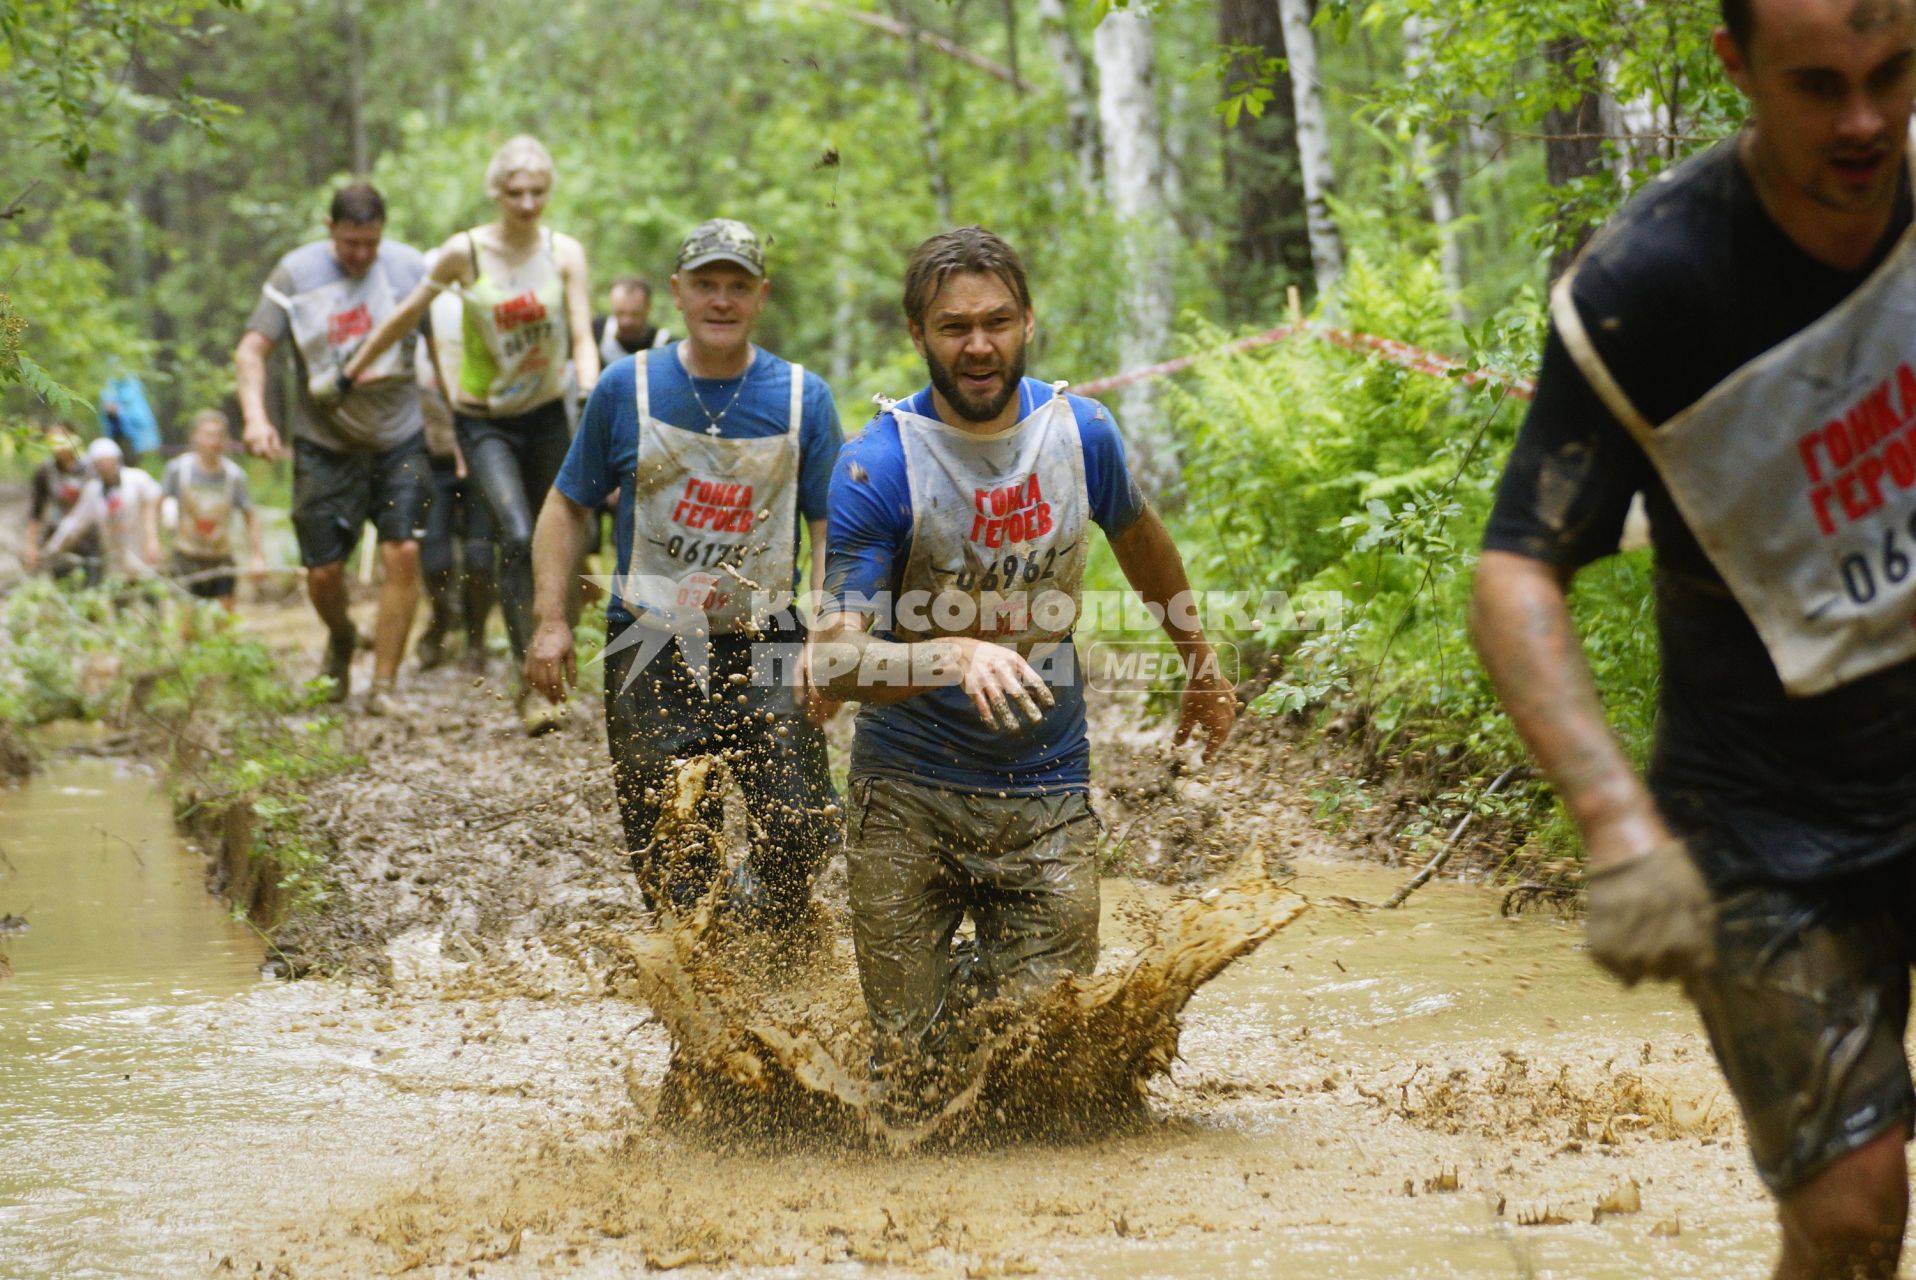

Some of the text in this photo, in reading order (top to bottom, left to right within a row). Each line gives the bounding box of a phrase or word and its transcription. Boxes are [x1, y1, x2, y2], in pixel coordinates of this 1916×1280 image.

[684, 477, 753, 508] ГОНКА
[975, 473, 1042, 517] ГОКА
[672, 500, 754, 533] ГЕРОЕВ
